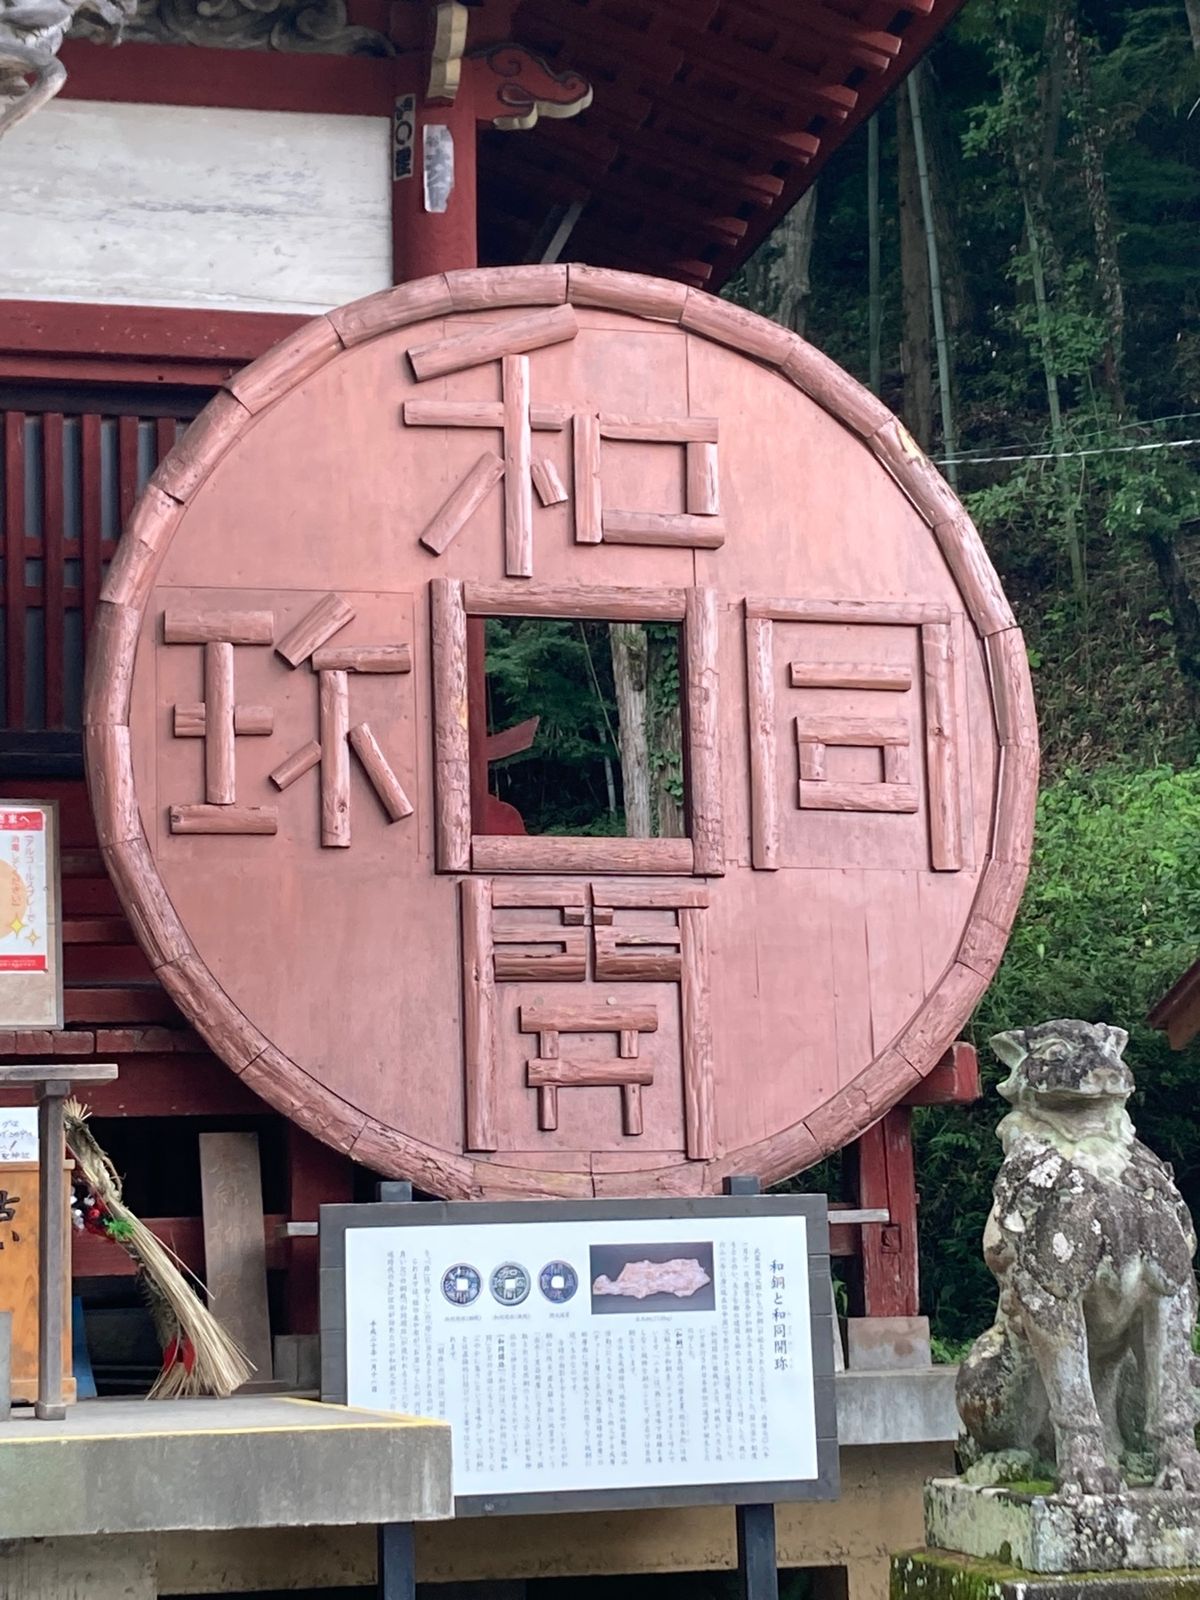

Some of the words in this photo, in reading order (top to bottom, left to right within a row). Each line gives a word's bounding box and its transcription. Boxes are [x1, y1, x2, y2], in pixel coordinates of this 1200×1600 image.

[402, 303, 726, 578] 和
[743, 596, 962, 872] 同
[769, 1259, 789, 1371] 和銅と和同開珎
